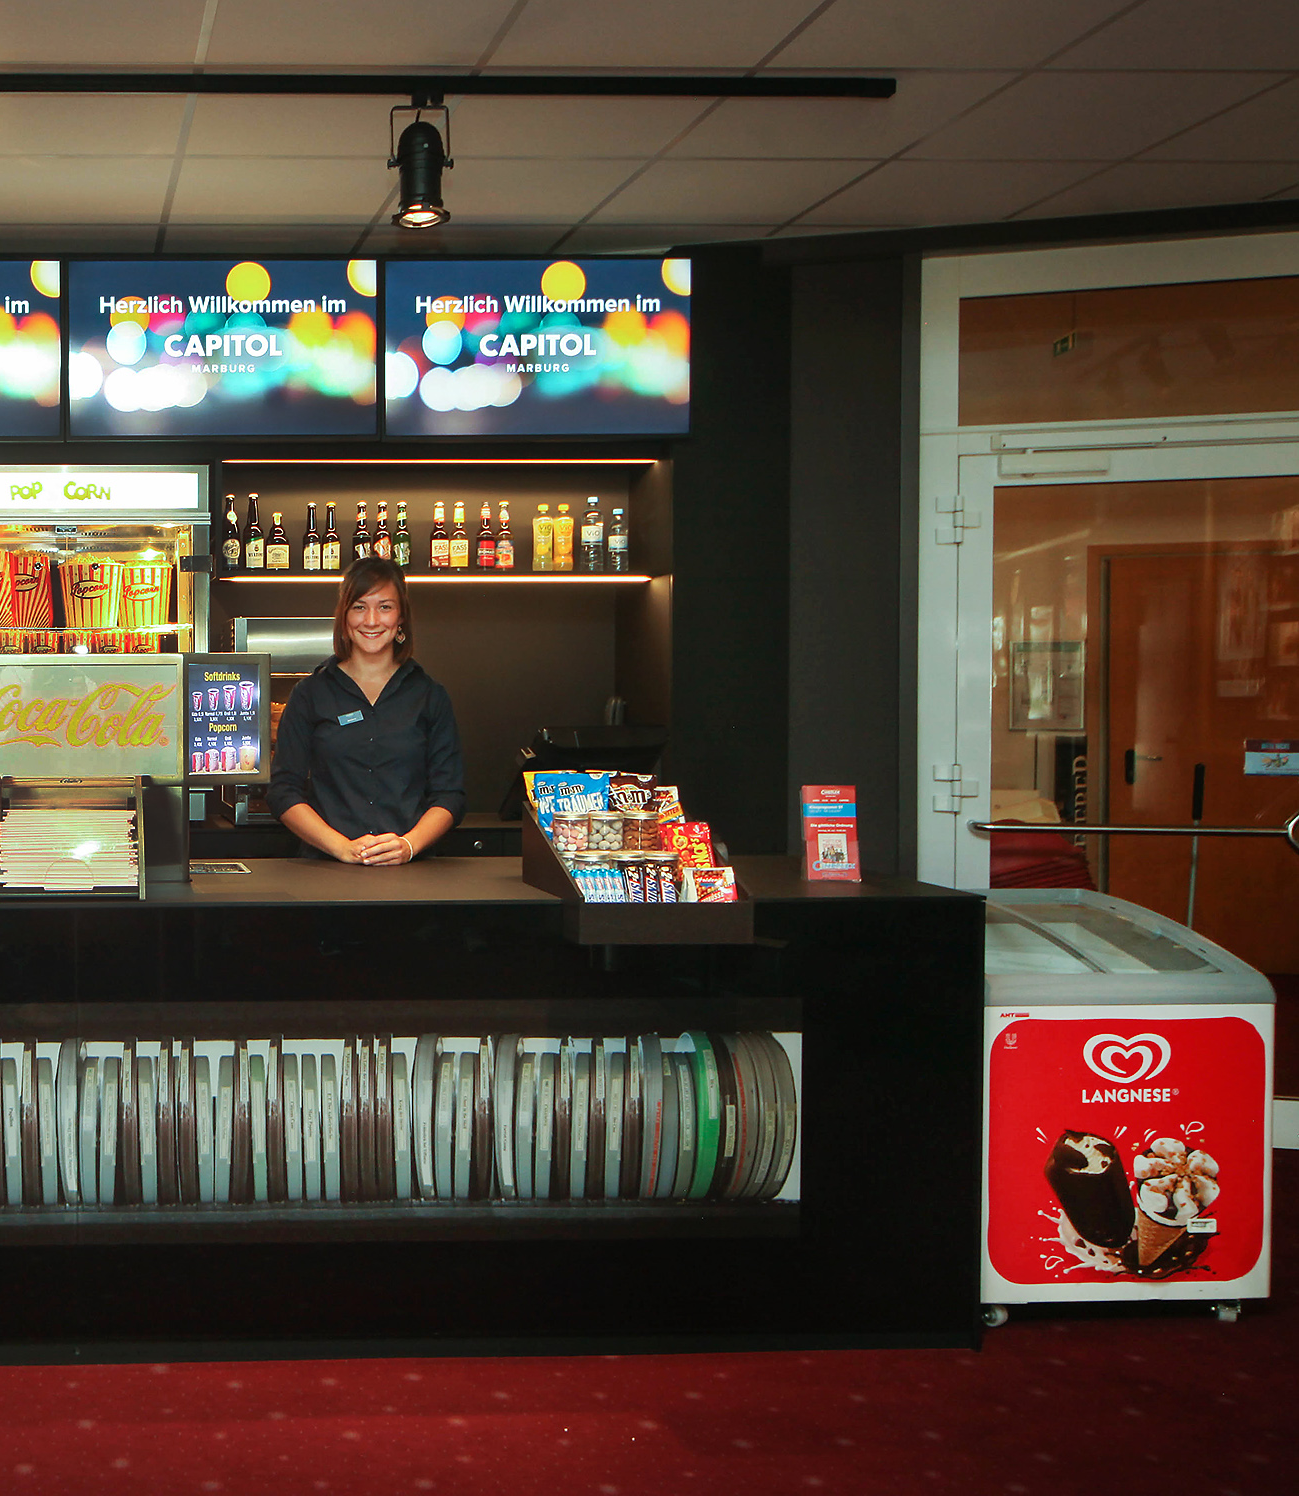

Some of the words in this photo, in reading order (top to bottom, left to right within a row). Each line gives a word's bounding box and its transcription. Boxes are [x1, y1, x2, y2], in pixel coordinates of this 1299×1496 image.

[4, 296, 30, 313] im
[99, 295, 183, 314] Herzlich
[188, 295, 317, 314] Willkommen
[321, 296, 346, 313] im
[415, 295, 498, 314] Herzlich
[502, 295, 632, 314] Willkommen
[635, 296, 661, 313] im
[164, 333, 283, 358] CAPITOL
[479, 333, 597, 358] CAPITOL
[191, 364, 255, 374] MARBURG
[506, 364, 570, 374] MARBURG
[10, 481, 43, 500] POP
[204, 671, 241, 682] Softdrinks
[209, 723, 237, 733] Popcorn
[1082, 1088, 1171, 1103] LANGNESE
